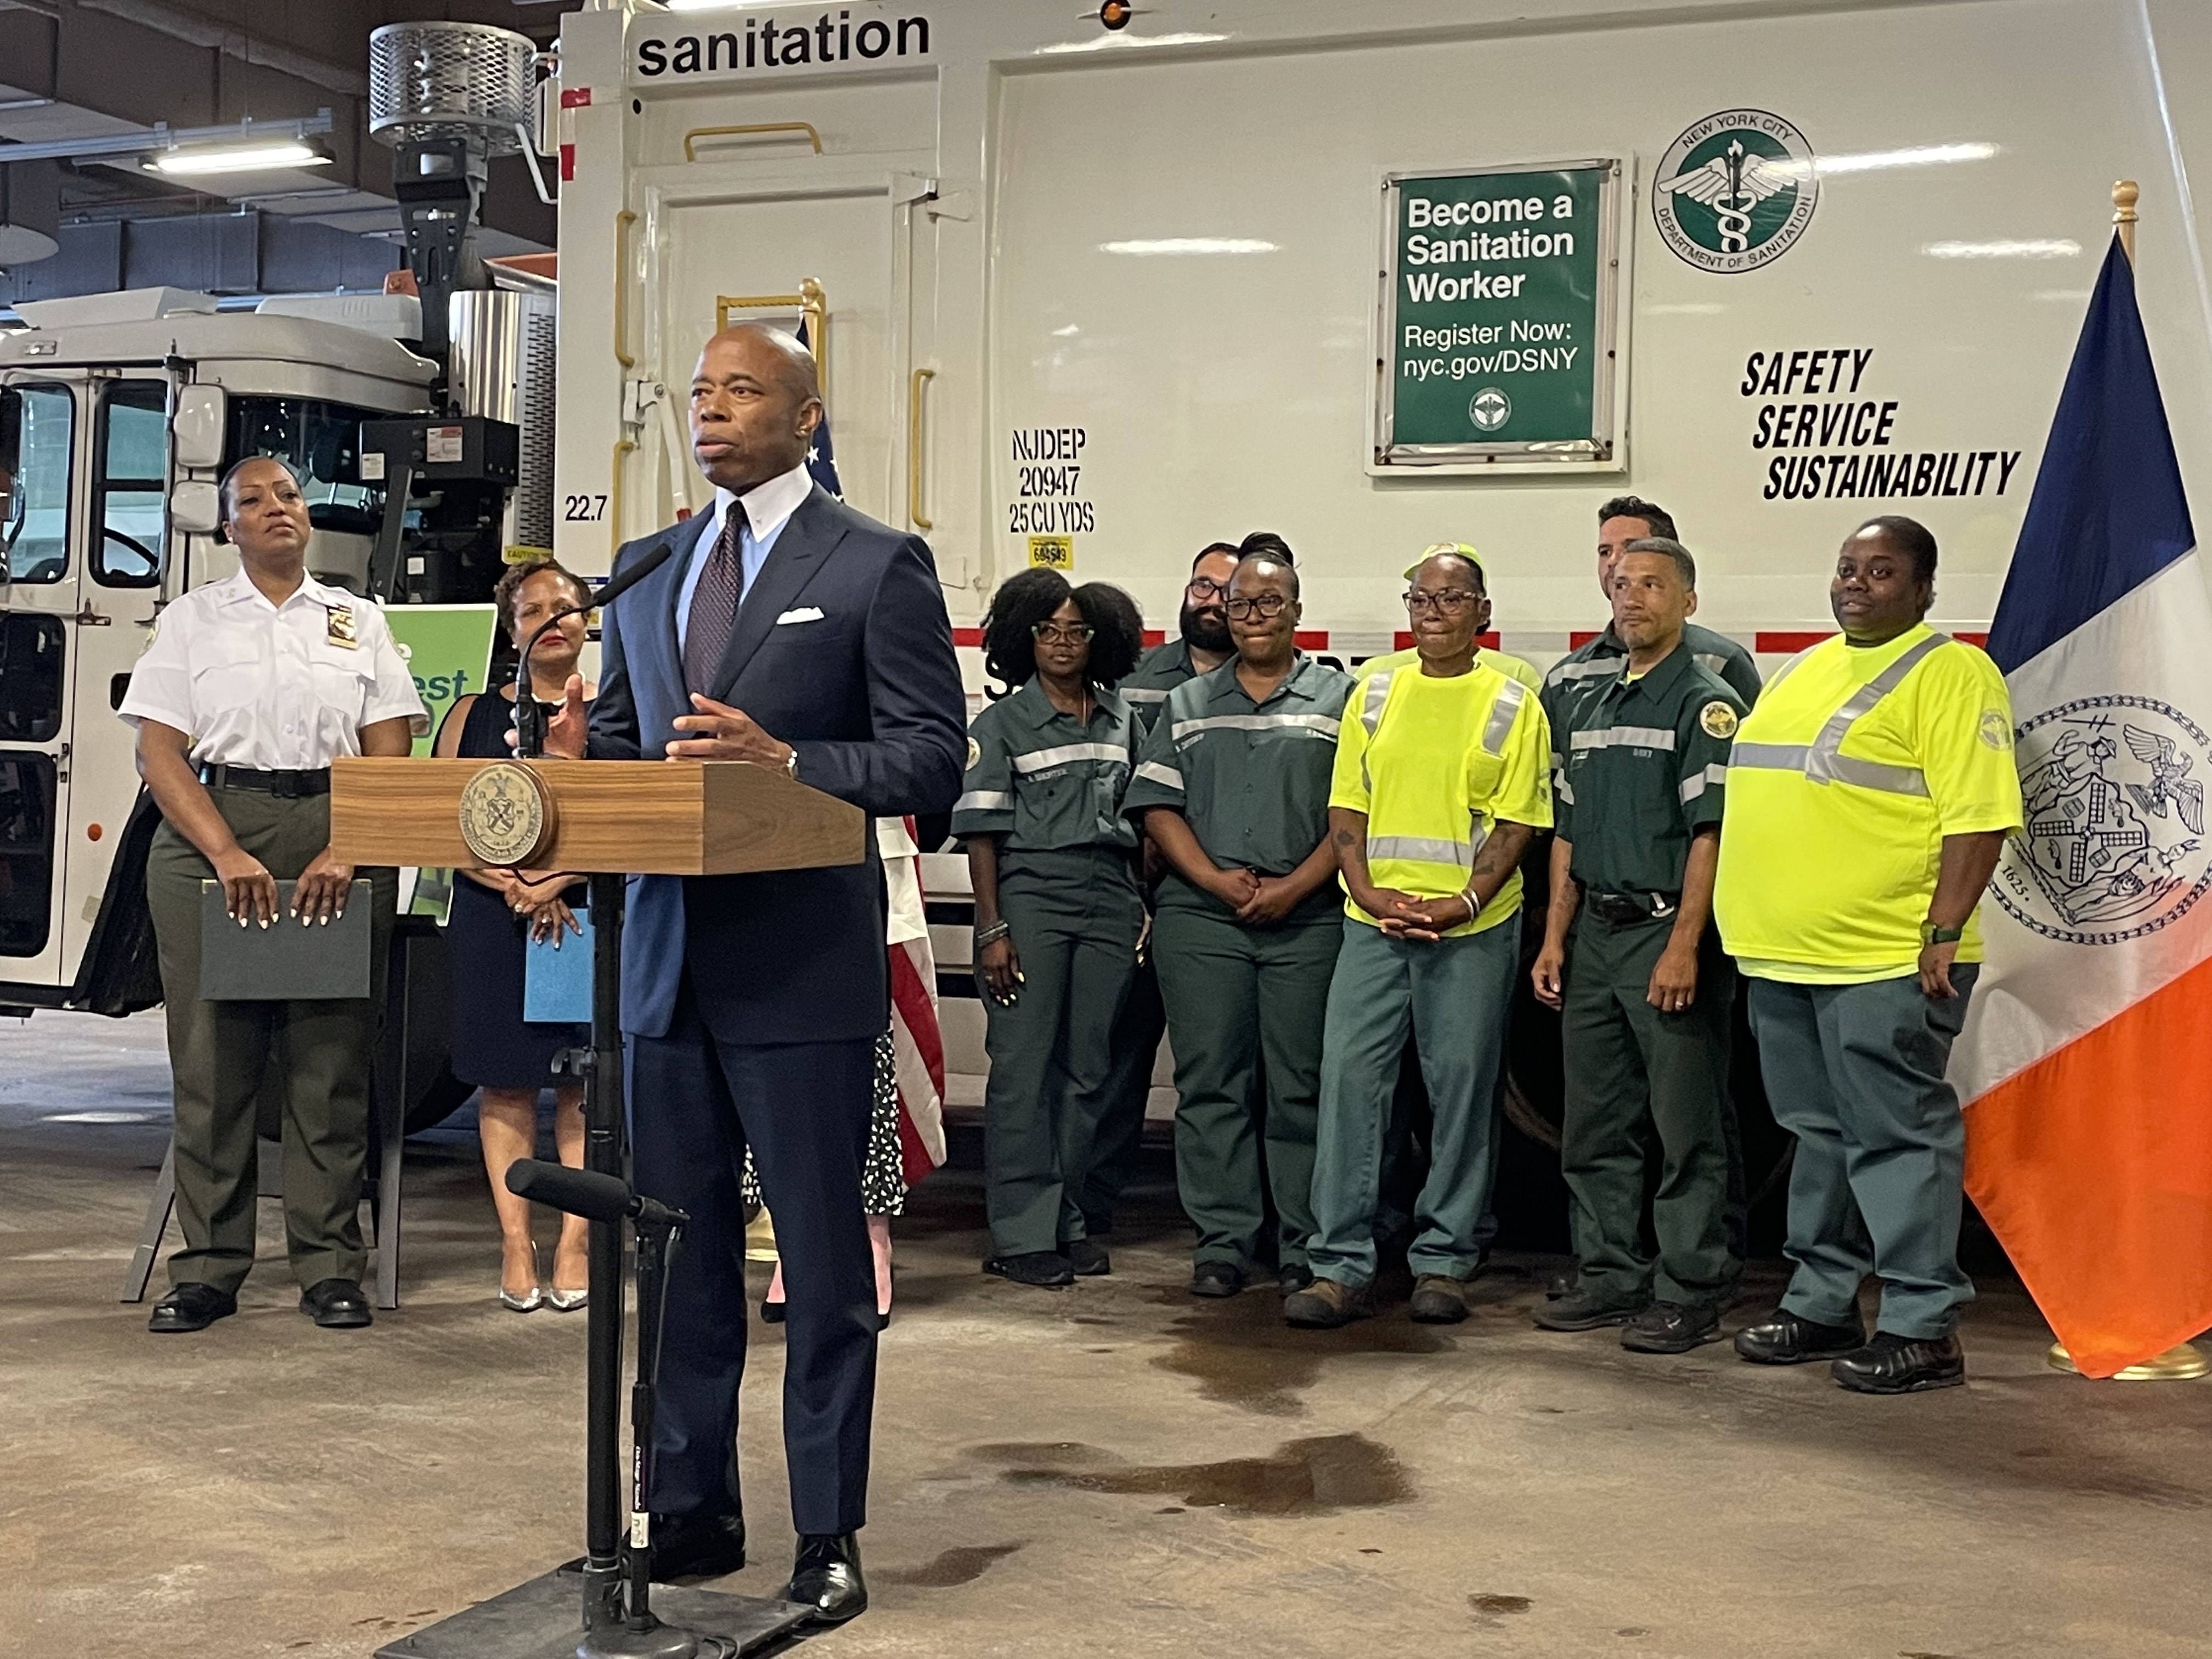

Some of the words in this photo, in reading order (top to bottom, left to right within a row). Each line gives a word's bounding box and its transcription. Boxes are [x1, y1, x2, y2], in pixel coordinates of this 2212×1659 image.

[638, 10, 929, 76] sanitation
[1682, 122, 1713, 148] NEW
[1717, 114, 1759, 128] YORK
[1763, 119, 1793, 141] CITY
[1408, 197, 1544, 228] Become
[1553, 195, 1572, 219] a
[1407, 228, 1573, 265] Sanitation
[1658, 207, 1724, 268] DEPARTMENT
[1728, 258, 1744, 268] OF
[1748, 196, 1812, 264] SANITATION
[1406, 270, 1526, 302] Worker
[1405, 323, 1503, 352] Register
[1510, 319, 1571, 342] Now:
[1404, 346, 1578, 382] nyc.gov/DSNY
[1741, 348, 1874, 397] SAFETY
[1752, 401, 1899, 449] SERVICE
[1012, 428, 1086, 460] NJDEP
[1019, 466, 1081, 496] 20947
[1763, 451, 2022, 500] SUSTAINABILITY
[565, 495, 608, 521] 22.7
[1009, 503, 1029, 533] 25
[1031, 502, 1055, 533] CU
[1058, 501, 1094, 533] YDS
[2001, 865, 2028, 895] 1625
